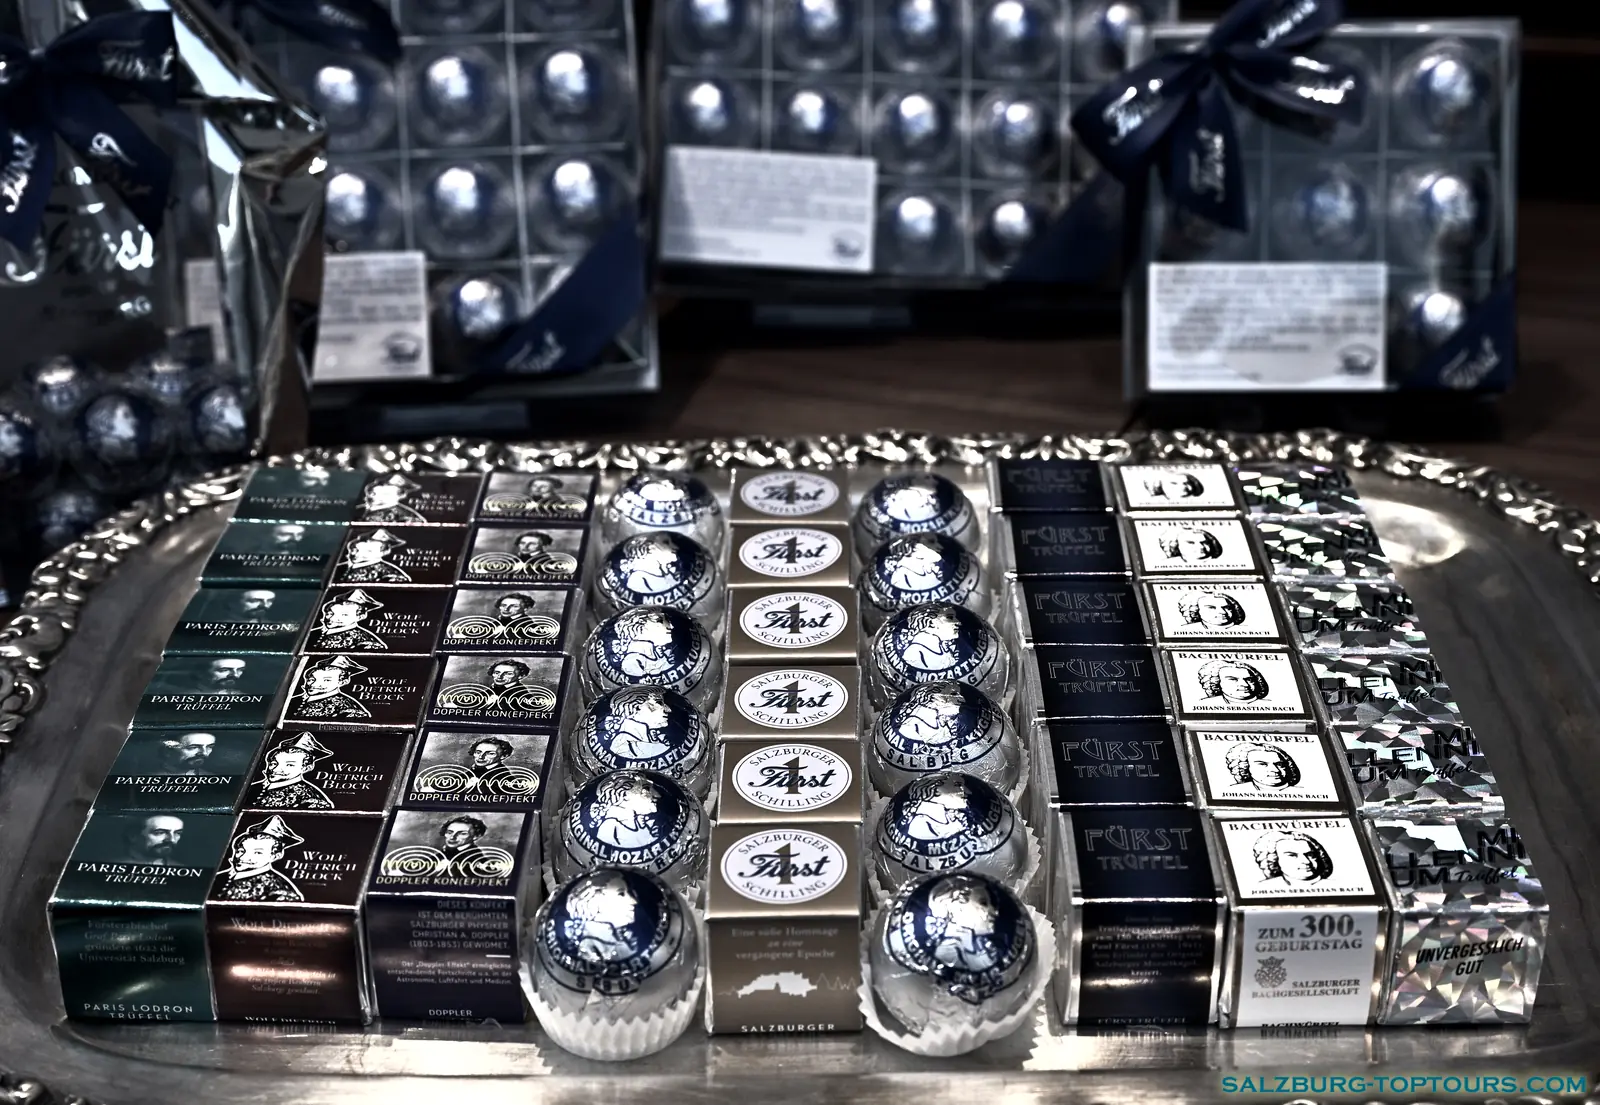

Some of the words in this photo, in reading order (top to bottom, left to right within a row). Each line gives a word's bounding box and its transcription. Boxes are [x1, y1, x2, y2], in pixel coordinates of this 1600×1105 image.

[220, 553, 261, 562] PARIS
[263, 554, 321, 562] LODRON
[755, 595, 833, 611] SALZBURGER
[1034, 590, 1126, 610] FÜRST
[383, 612, 421, 621] WOLF
[185, 622, 228, 630] PARIS
[231, 622, 291, 631] LODRON
[369, 619, 430, 627] DIETRICH
[208, 629, 261, 638] TRÜFFEL
[375, 626, 420, 635] BLOCK
[442, 637, 489, 646] DOPPLER
[492, 637, 559, 646] KON(EF)FEKT
[758, 630, 829, 645] SCHILLING
[1178, 652, 1283, 661] BACHWÜRFEL
[1048, 658, 1145, 678] FÜRST
[367, 676, 408, 685] WOLF
[751, 673, 833, 689] SALZBURGER
[1058, 678, 1141, 693] TRÜFFEL
[352, 684, 416, 693] DIETRICH
[151, 695, 196, 703] PARIS
[199, 695, 262, 703] LODRON
[358, 691, 405, 701] BLOCK
[176, 702, 231, 711] TRÜFFEL
[433, 707, 481, 717] DOPPLER
[485, 709, 555, 720] KON(EF)FEKT
[752, 710, 828, 725] SCHILLING
[1203, 733, 1314, 743] BACHWÜRFEL
[1061, 738, 1164, 761] FÜRST
[750, 748, 836, 766] SALZBURGER
[332, 763, 375, 773] WOLF
[1074, 763, 1160, 778] TRÜFFEL
[115, 776, 161, 785] PARIS
[164, 776, 232, 785] LODRON
[315, 771, 384, 781] DIETRICH
[140, 784, 199, 793] TRÜFFEL
[322, 780, 371, 790] BLOCK
[409, 792, 460, 802] DOPPLER
[464, 793, 537, 803] KON(EF)FEKT
[752, 790, 832, 807] SCHILLING
[1229, 819, 1346, 831] BACHWÜRFEL
[1084, 825, 1192, 851] FÜRST
[738, 834, 829, 854] SALZBURGER
[303, 851, 347, 862] WOLF
[1097, 854, 1189, 870] TRÜFFEL
[77, 862, 127, 874] PARIS
[131, 866, 203, 878] LODRON
[284, 859, 357, 872] DIETRICH
[105, 873, 168, 885] TRÜFFEL
[291, 868, 343, 881] BLOCK
[376, 876, 429, 885] DOPPLER
[433, 876, 511, 887] KON(EF)FEKT
[742, 879, 827, 898] SCHILLING
[409, 920, 465, 929] SALZBURGER
[1258, 928, 1295, 939] ZUM
[1299, 914, 1362, 938] 300.
[411, 930, 457, 939] CHRISTIAN
[471, 931, 510, 940] DOPPLER
[1255, 939, 1362, 953] GEBURTSTAG
[1415, 937, 1524, 964] UNVERGESSLICH
[1455, 960, 1484, 976] GUT
[1291, 979, 1360, 988] SALZBURGER
[1252, 987, 1360, 998] BACHGESELLSCHAFT
[83, 1003, 126, 1012] PARIS
[132, 1004, 194, 1014] LODRON
[428, 1009, 473, 1018] DOPPLER
[109, 1012, 171, 1020] TRÜFFEL
[741, 1024, 835, 1033] SALZBURGER
